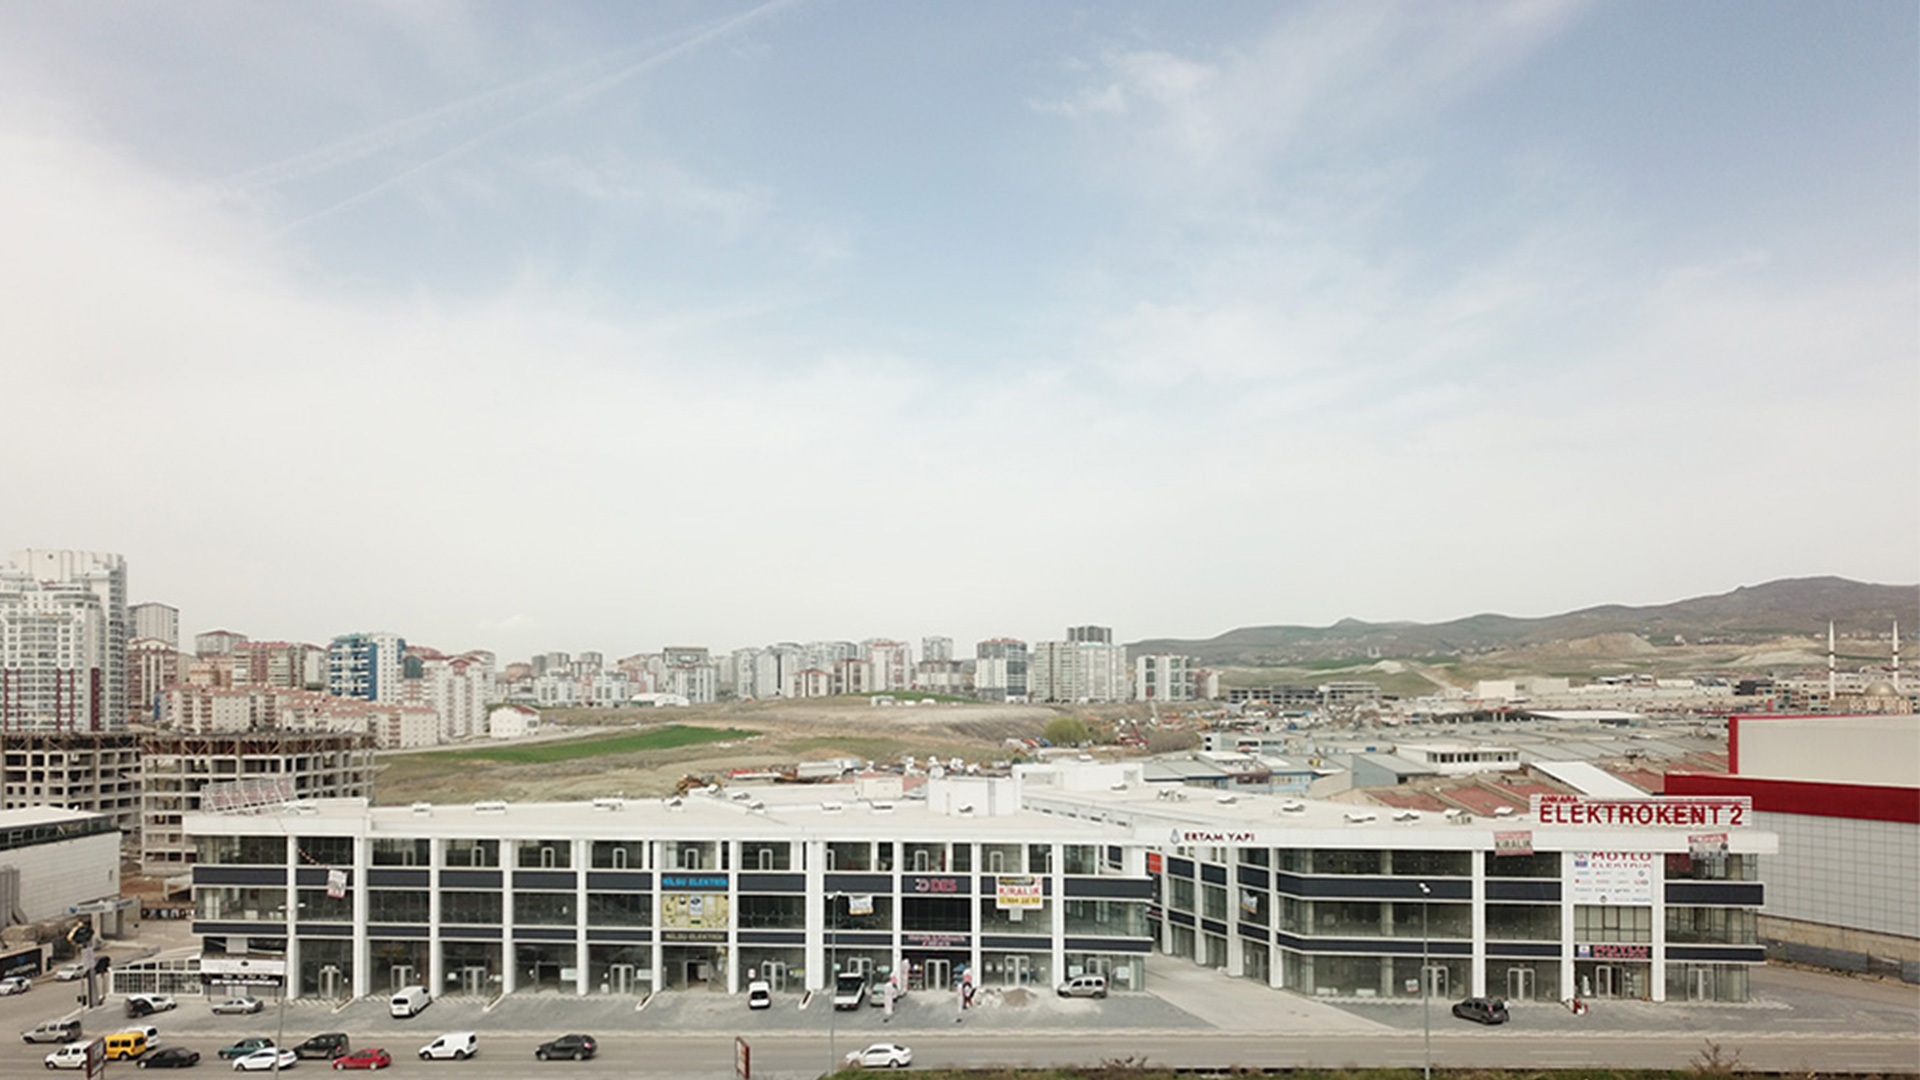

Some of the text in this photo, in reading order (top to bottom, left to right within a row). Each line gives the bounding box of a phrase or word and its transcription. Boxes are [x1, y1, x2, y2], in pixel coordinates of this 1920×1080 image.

[1540, 796, 1579, 804] ANKARA
[1540, 805, 1743, 825] ELEKTROKENT 2
[1184, 832, 1256, 841] ERTAM YAPI
[931, 879, 957, 892] DES
